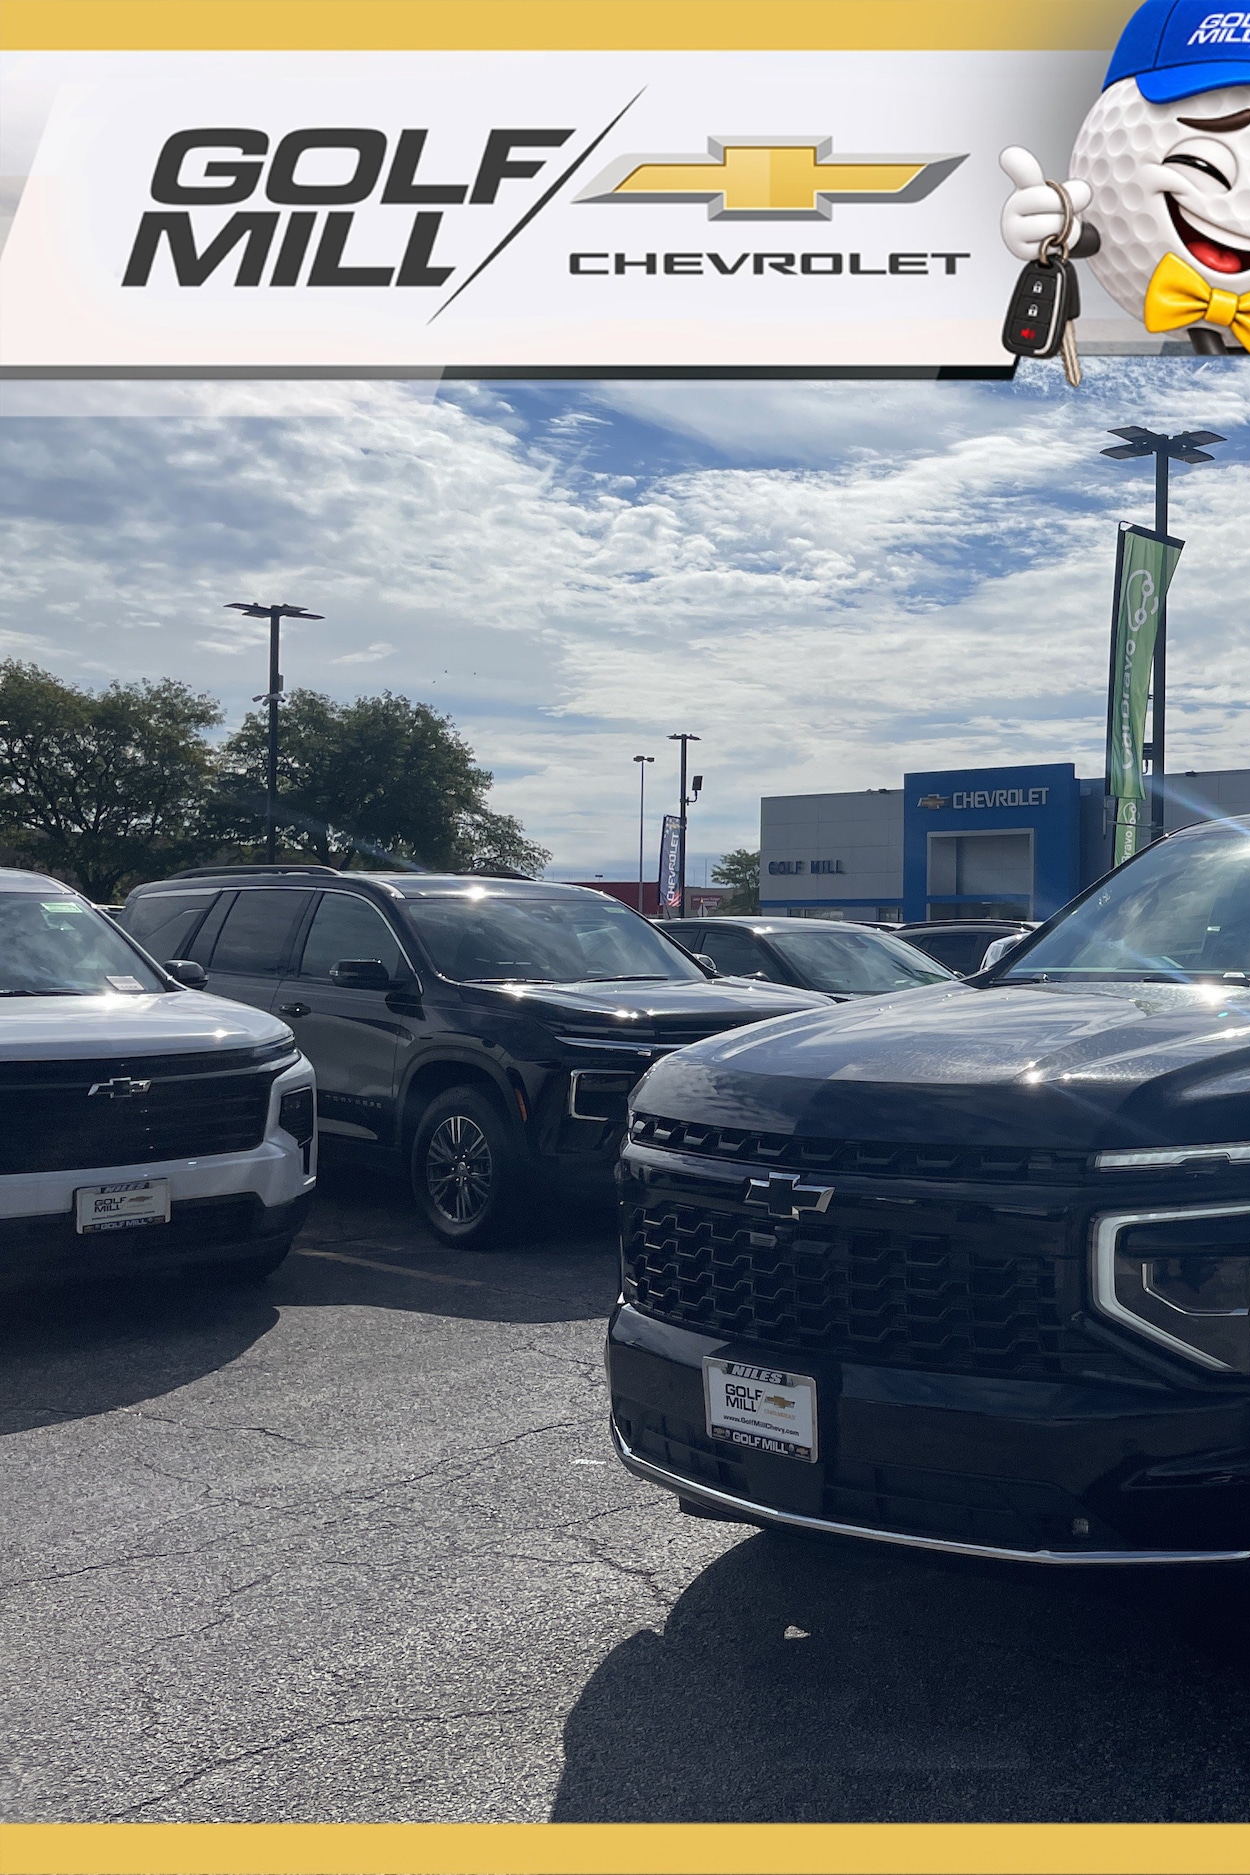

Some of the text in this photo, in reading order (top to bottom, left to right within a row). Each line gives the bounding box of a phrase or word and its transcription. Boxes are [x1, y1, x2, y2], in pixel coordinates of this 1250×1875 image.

[953, 786, 1050, 810] CHEVROLET
[666, 833, 680, 902] CHEVROLET
[768, 860, 844, 875] GOLF MILL
[94, 1196, 127, 1207] GOLF
[94, 1204, 121, 1213] MILL
[100, 1219, 148, 1230] GOLF MILL
[731, 1366, 783, 1384] NILES
[725, 1383, 763, 1401] GOLF
[725, 1395, 757, 1413] MILL
[732, 1431, 789, 1455] GOLF MILL
